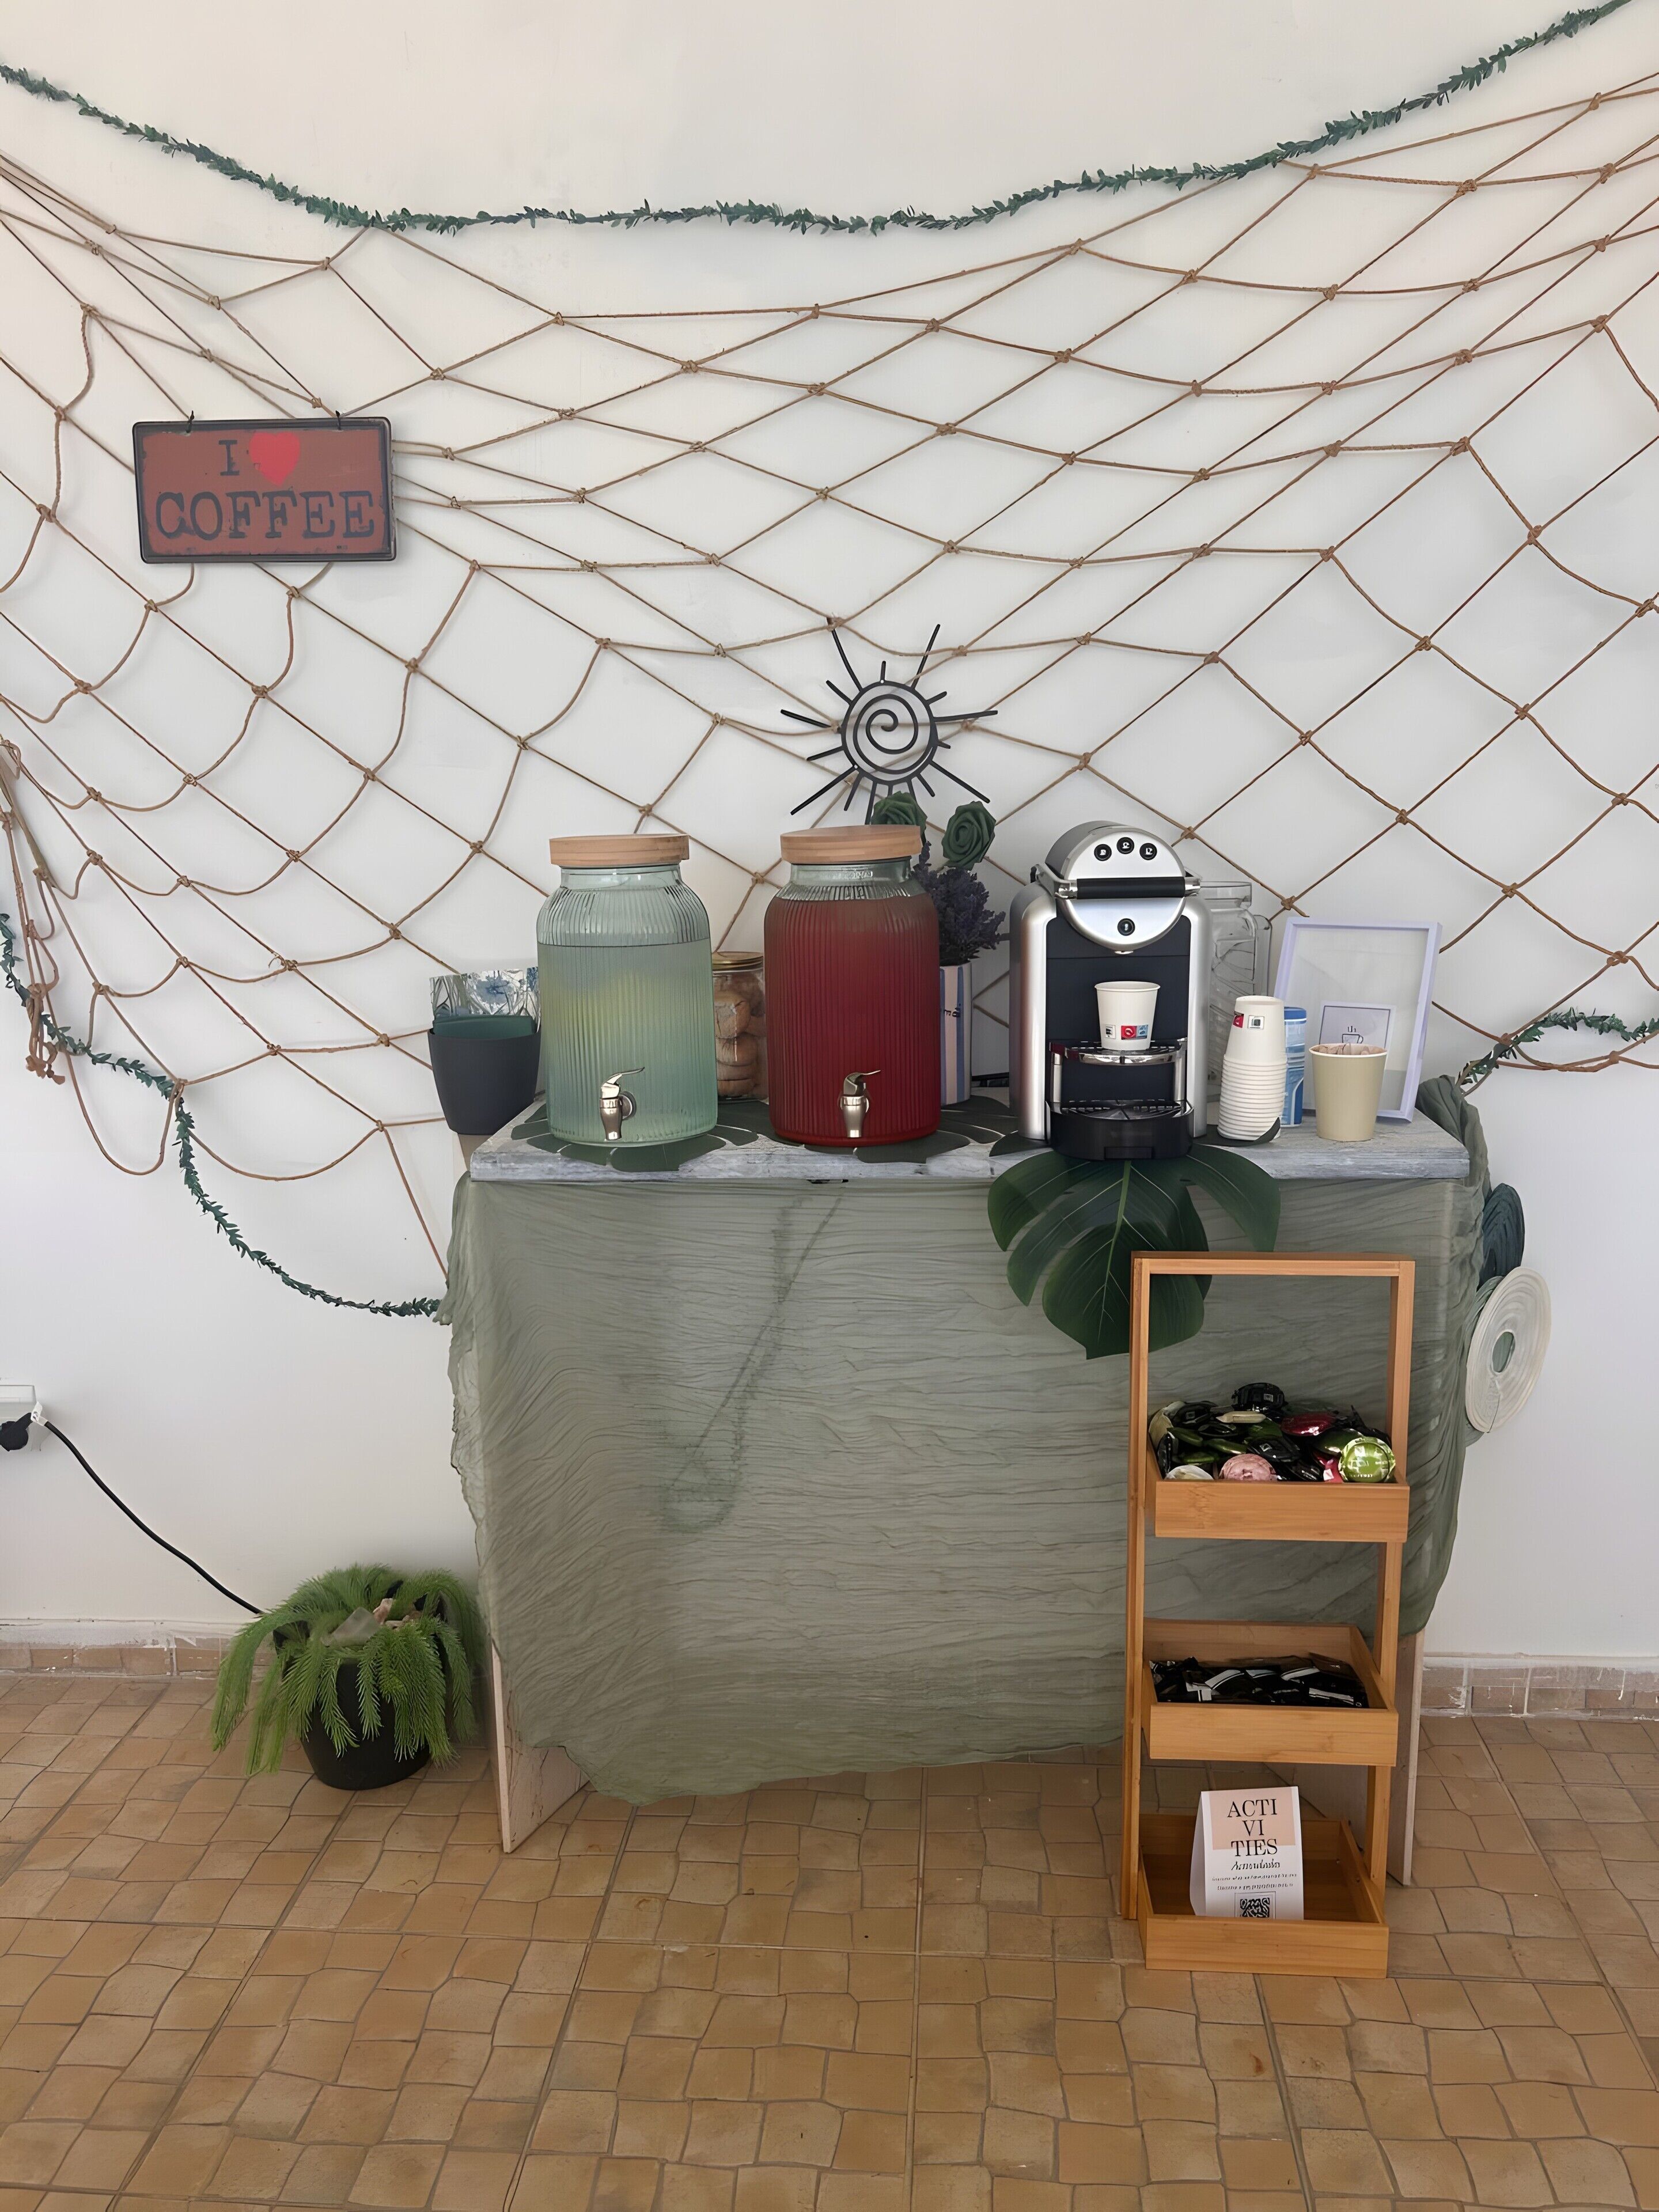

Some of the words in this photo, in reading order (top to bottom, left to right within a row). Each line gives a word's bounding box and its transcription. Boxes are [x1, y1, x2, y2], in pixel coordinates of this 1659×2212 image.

[218, 440, 240, 476] I
[156, 490, 374, 540] COFFEE
[1227, 1798, 1278, 1817] ACTI
[1242, 1819, 1264, 1836] VI
[1230, 1838, 1278, 1857] TIES
